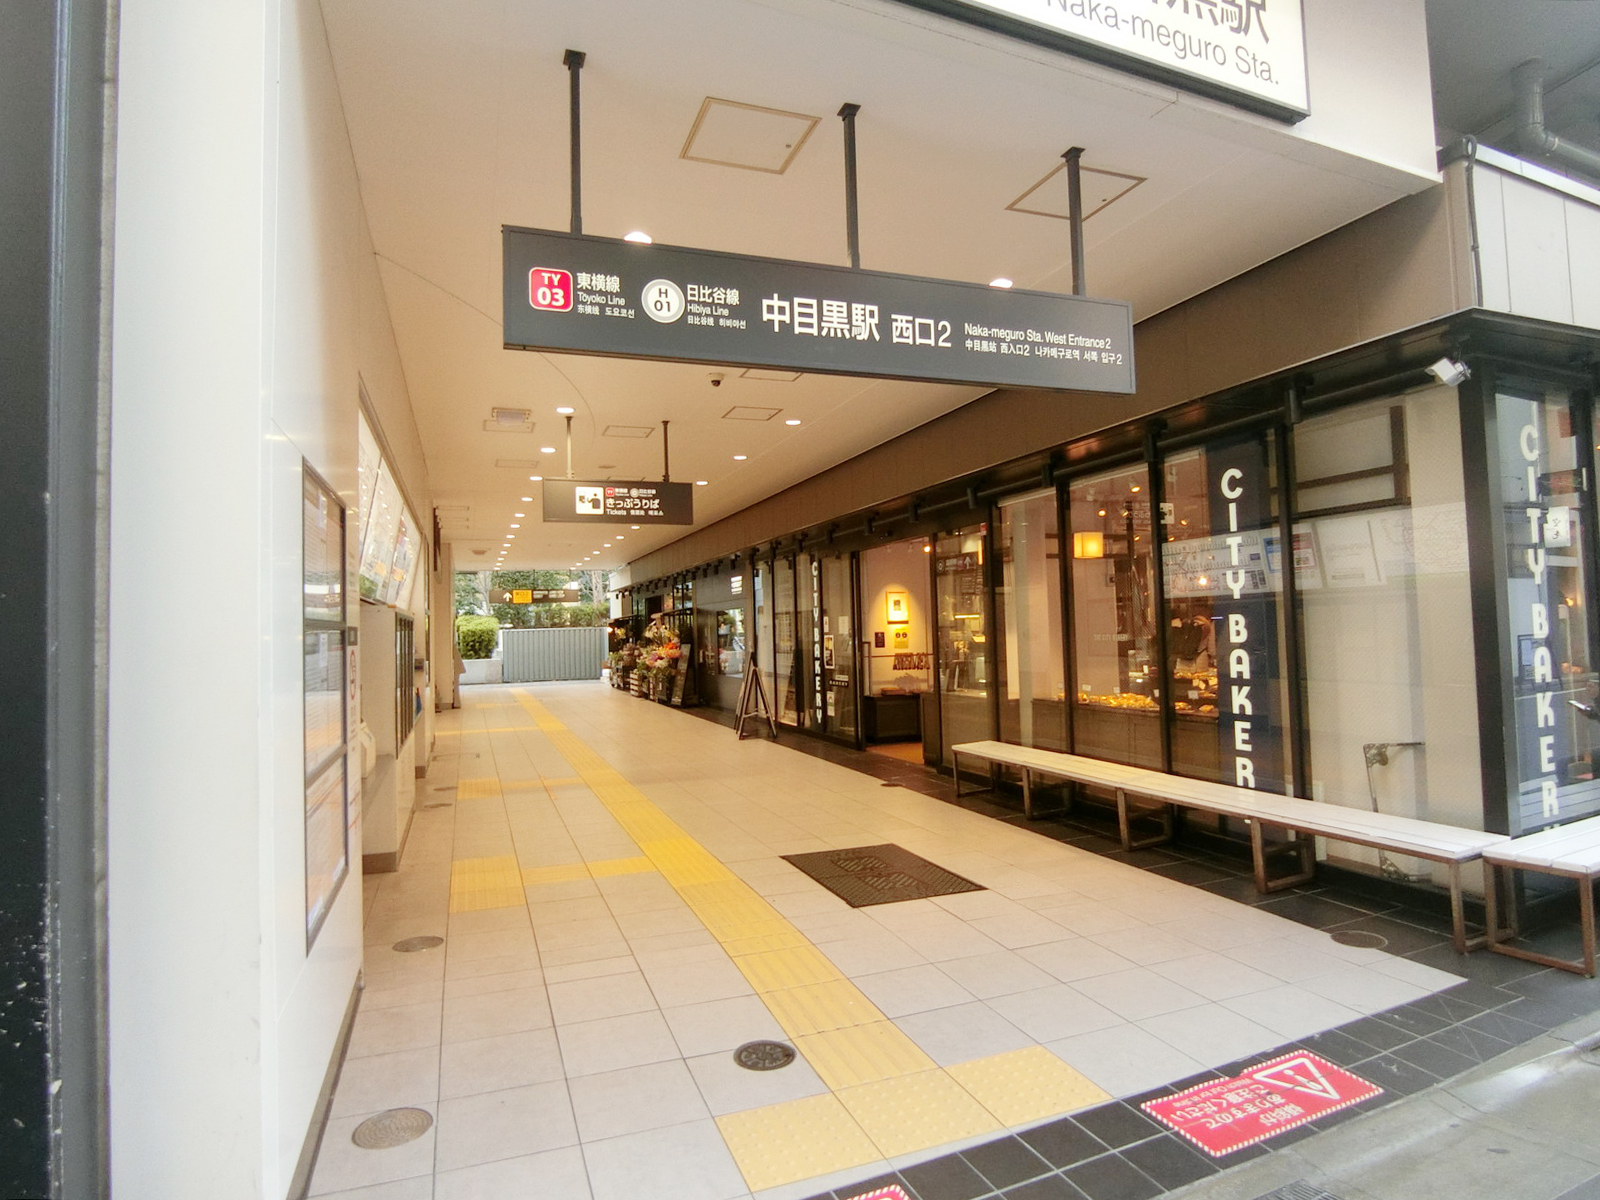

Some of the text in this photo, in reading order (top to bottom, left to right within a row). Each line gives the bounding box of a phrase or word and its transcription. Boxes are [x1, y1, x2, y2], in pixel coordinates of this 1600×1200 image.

[1235, 45, 1280, 85] Sta.
[541, 272, 561, 286] TY
[577, 272, 620, 293] 東横線
[537, 286, 565, 307] 03
[608, 294, 626, 306] Line
[658, 287, 669, 299] H
[687, 284, 740, 306] 日比谷線
[653, 300, 671, 313] 01
[687, 303, 730, 317] Hibiya Line
[762, 293, 952, 348] 中目黒駅 西口2
[964, 322, 1025, 343] Naka-meguro
[1026, 328, 1044, 343] Sta.
[1044, 331, 1067, 345] West
[1035, 345, 1081, 361] 나카메구로역
[606, 498, 660, 509] きっぷうりば
[606, 508, 627, 516] Tickets
[1519, 424, 1560, 832] CITY BAKER
[1220, 468, 1256, 824] CITY BAKER
[813, 627, 823, 724] BAKERY
[1170, 1084, 1270, 1121] ご注意ください
[1199, 1093, 1286, 1129] ありますので
